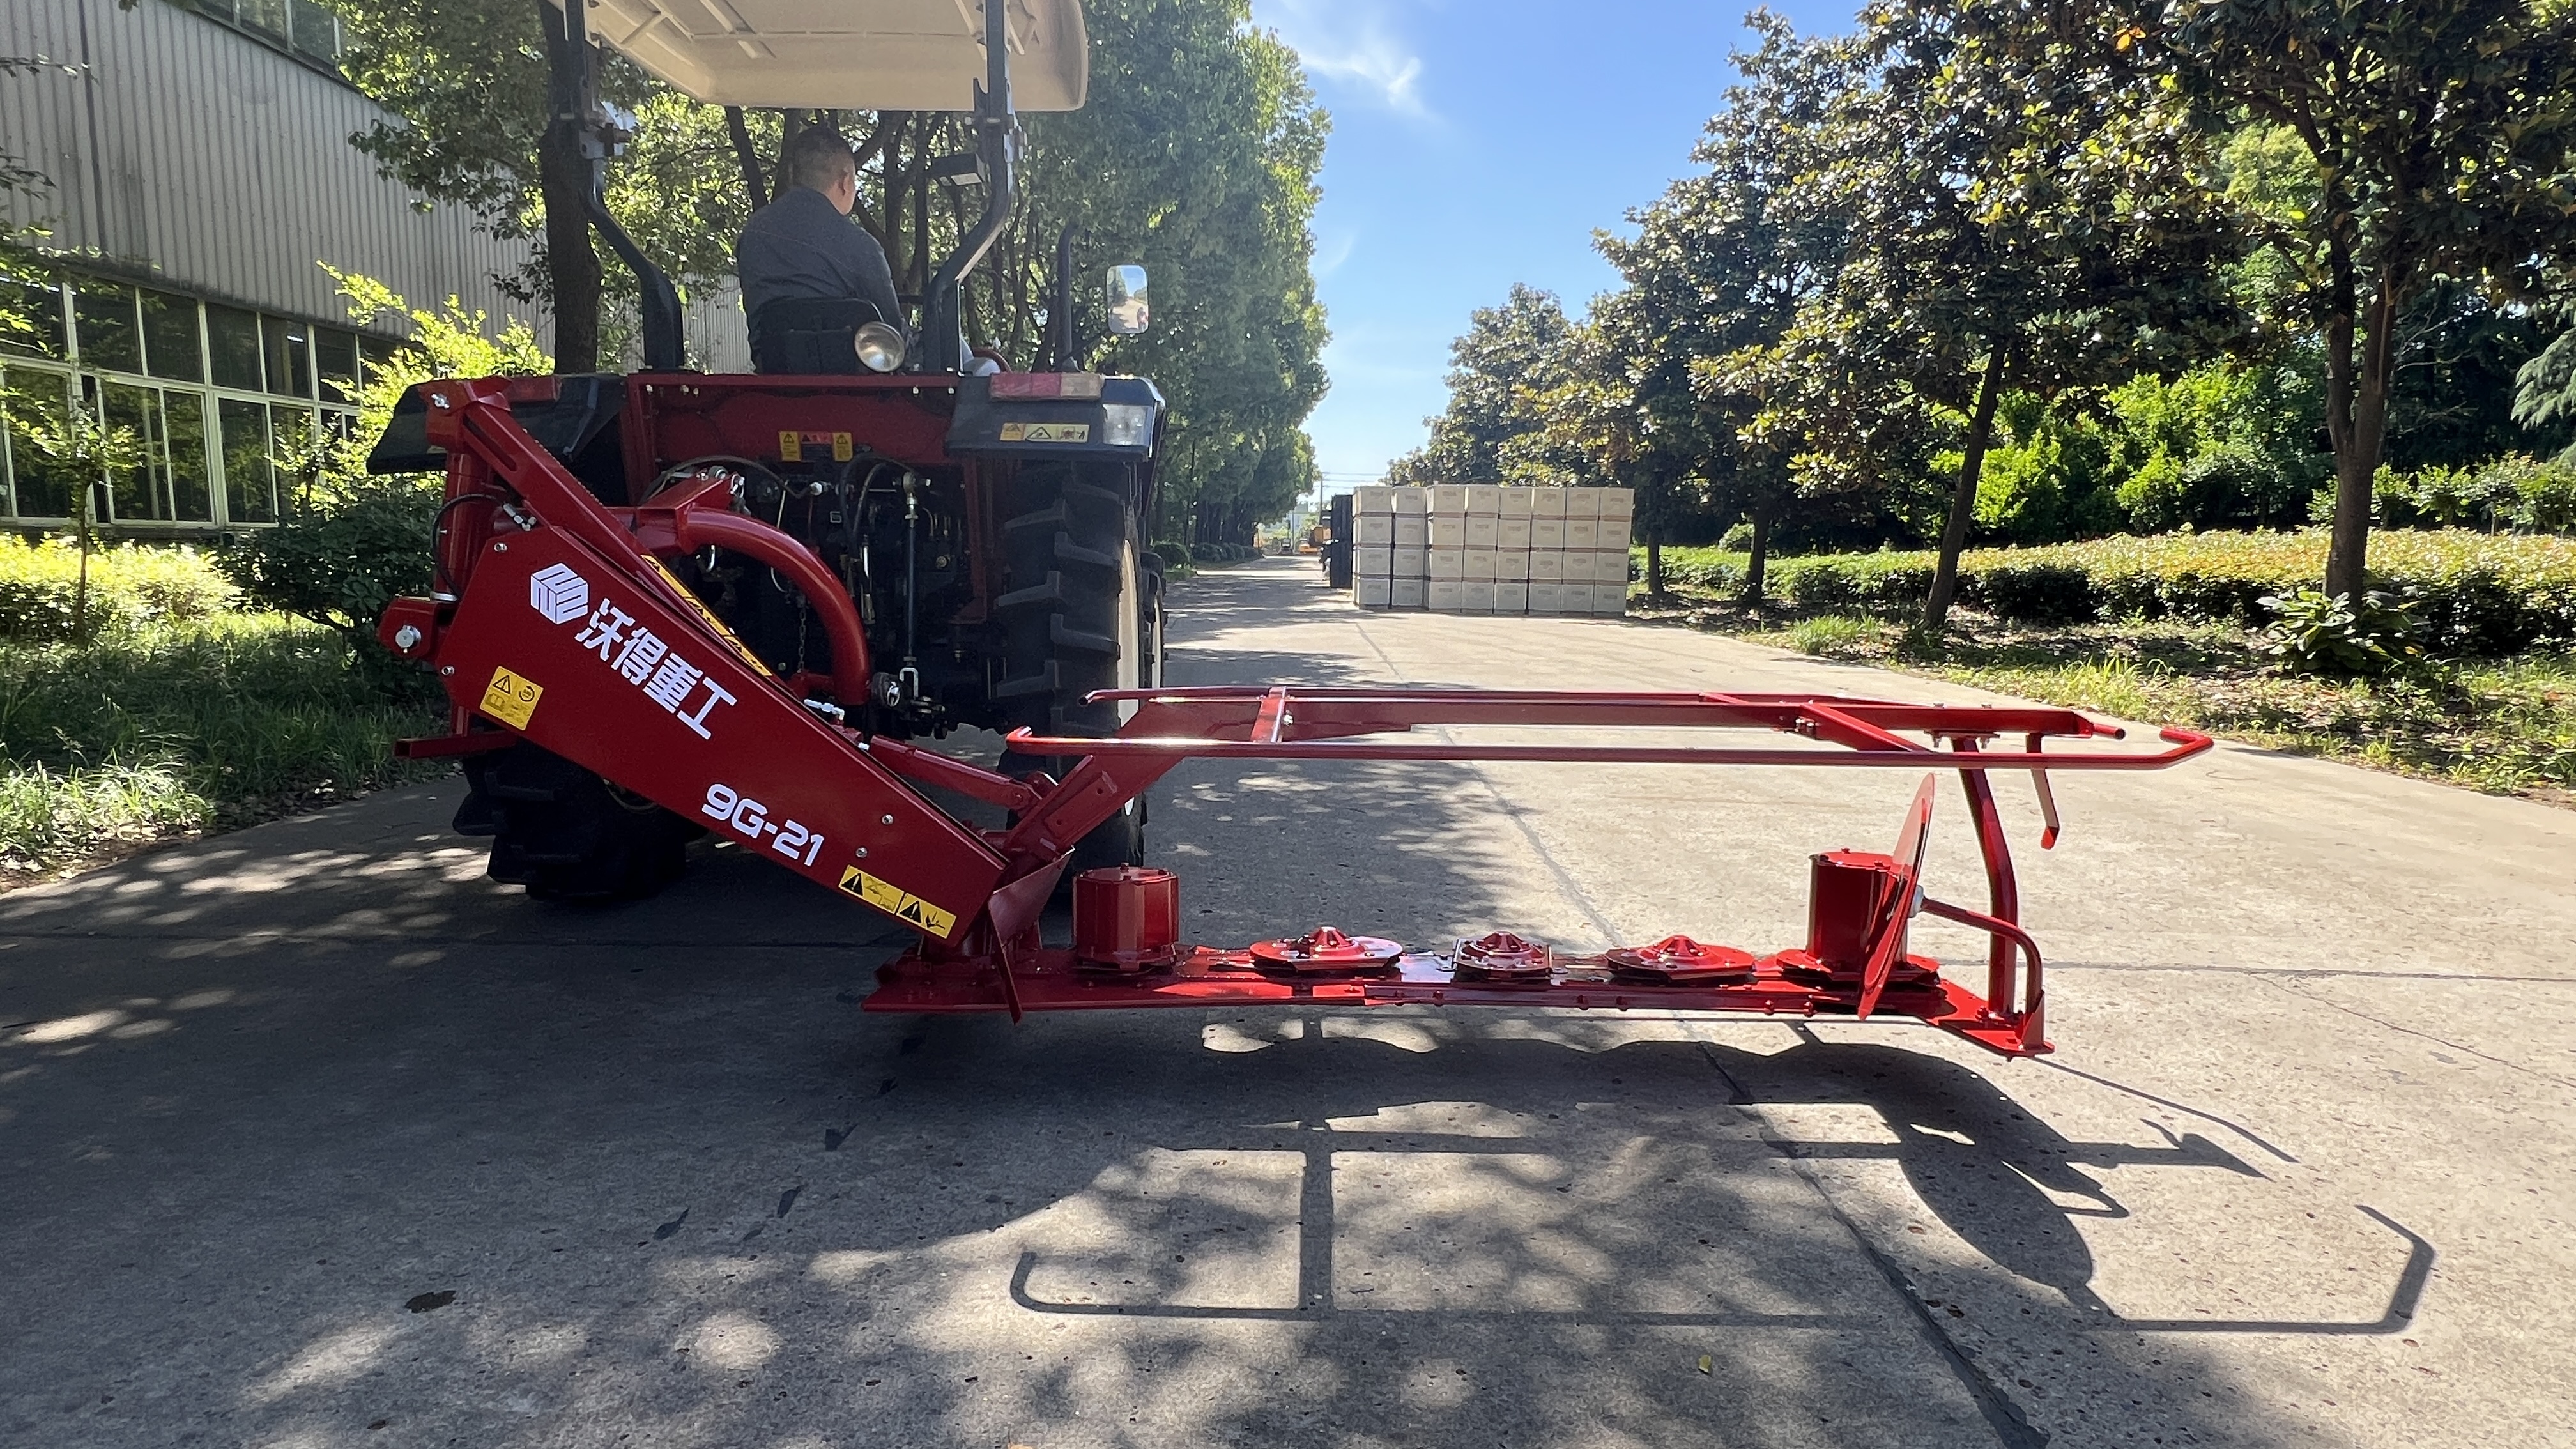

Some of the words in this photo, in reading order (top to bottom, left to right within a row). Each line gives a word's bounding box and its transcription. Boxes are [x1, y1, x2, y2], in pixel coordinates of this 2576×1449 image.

[574, 598, 737, 740] 沃得重工
[702, 783, 824, 866] 9G-21
